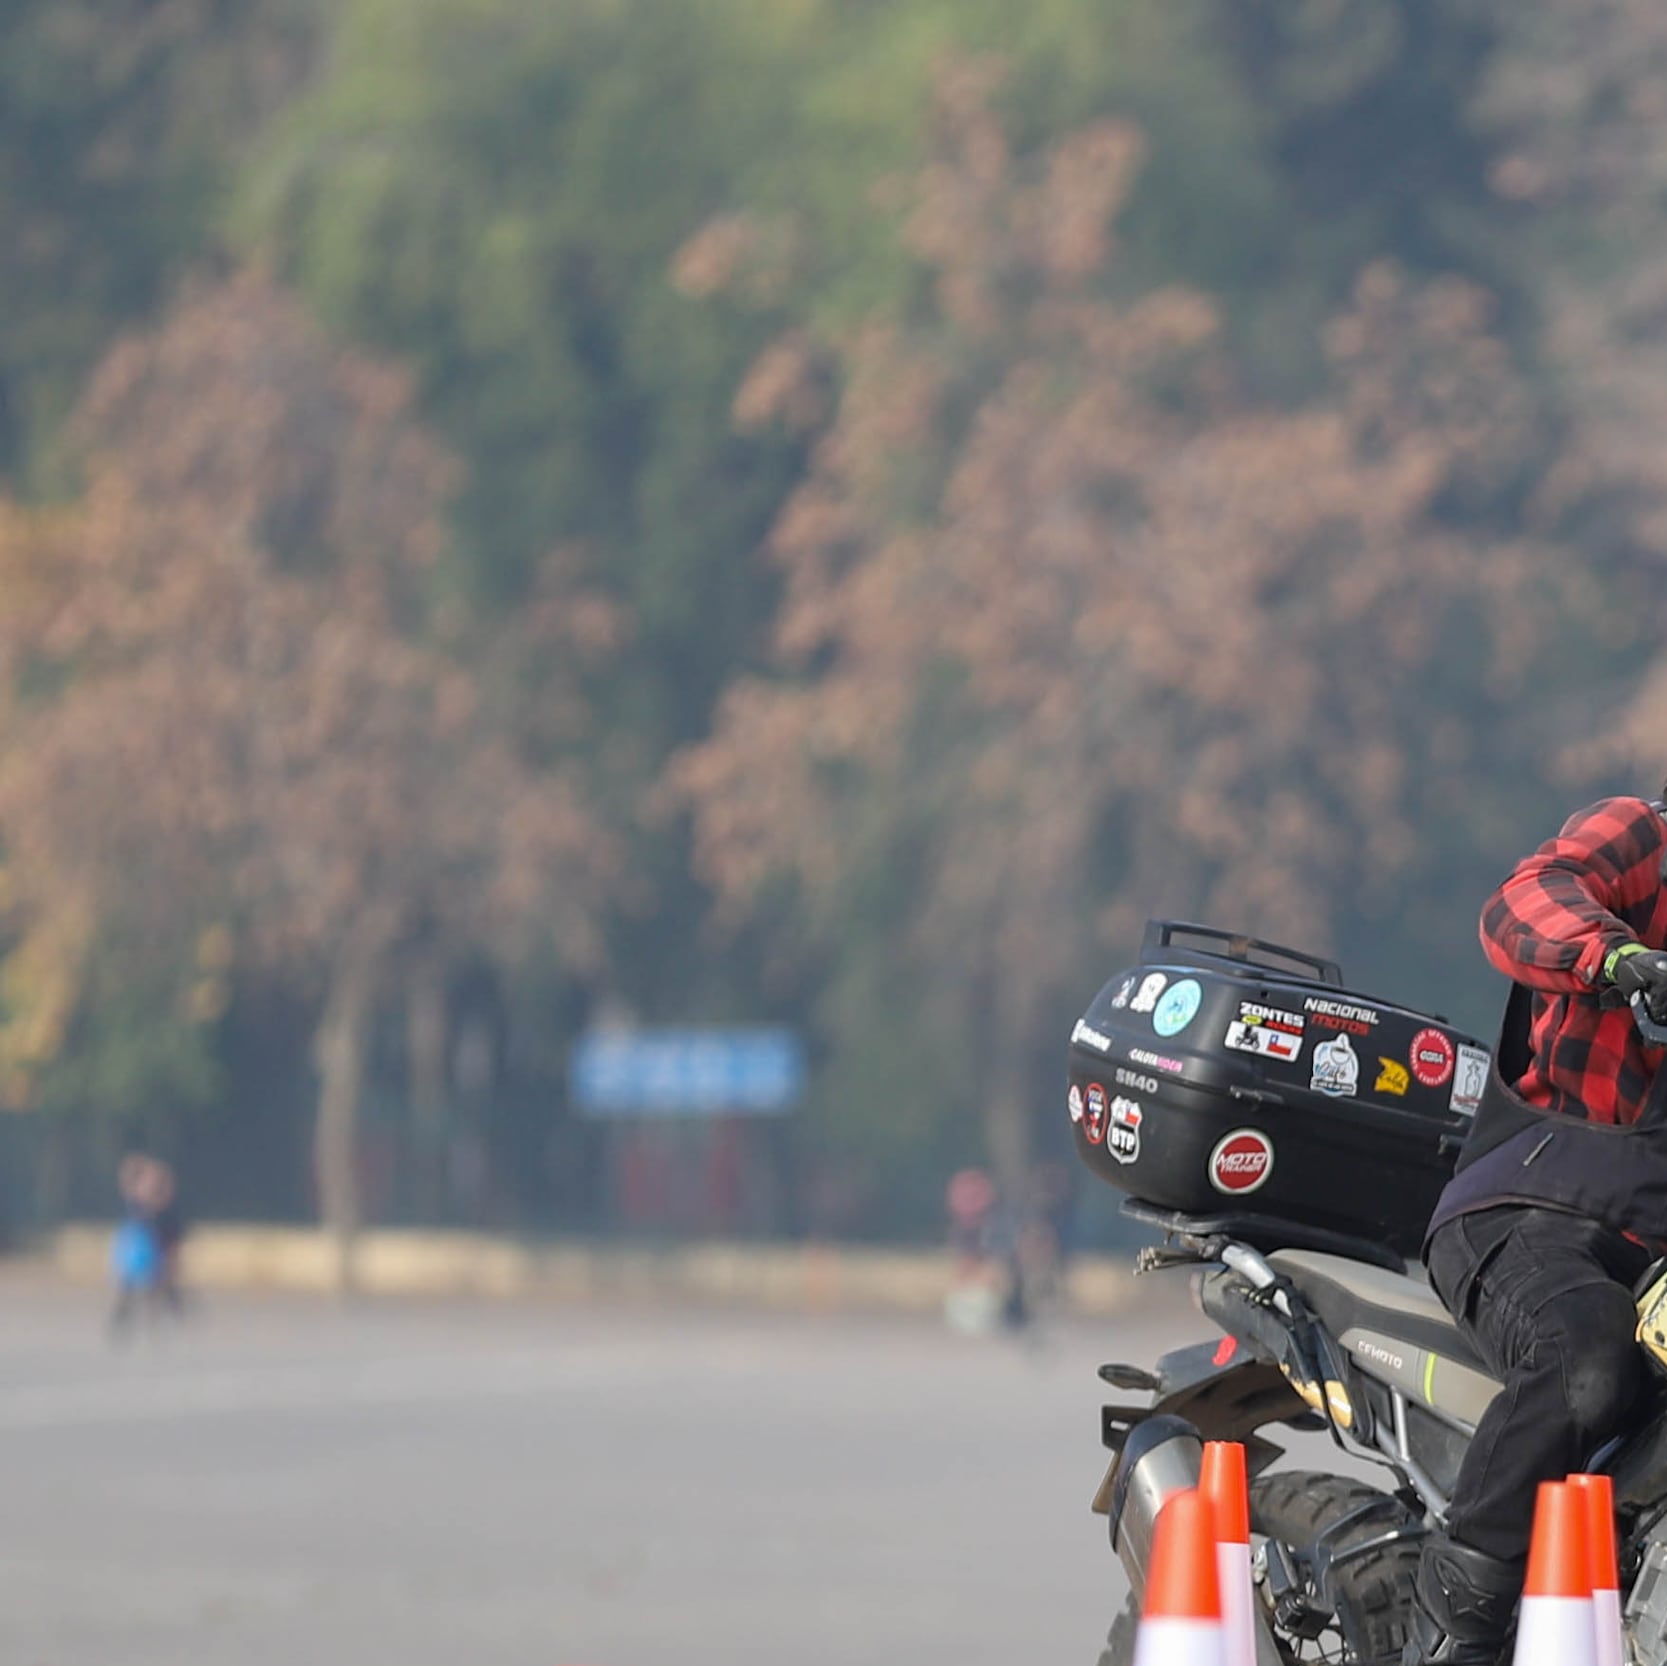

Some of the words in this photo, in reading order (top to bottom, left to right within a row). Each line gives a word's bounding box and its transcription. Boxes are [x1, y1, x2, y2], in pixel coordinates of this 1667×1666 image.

[1240, 1002, 1304, 1027] ZONTES
[1115, 1067, 1158, 1094] SH40
[1111, 1127, 1135, 1152] BTP
[1217, 1152, 1267, 1166] MOTO
[1358, 1340, 1402, 1370] CFMOTO
